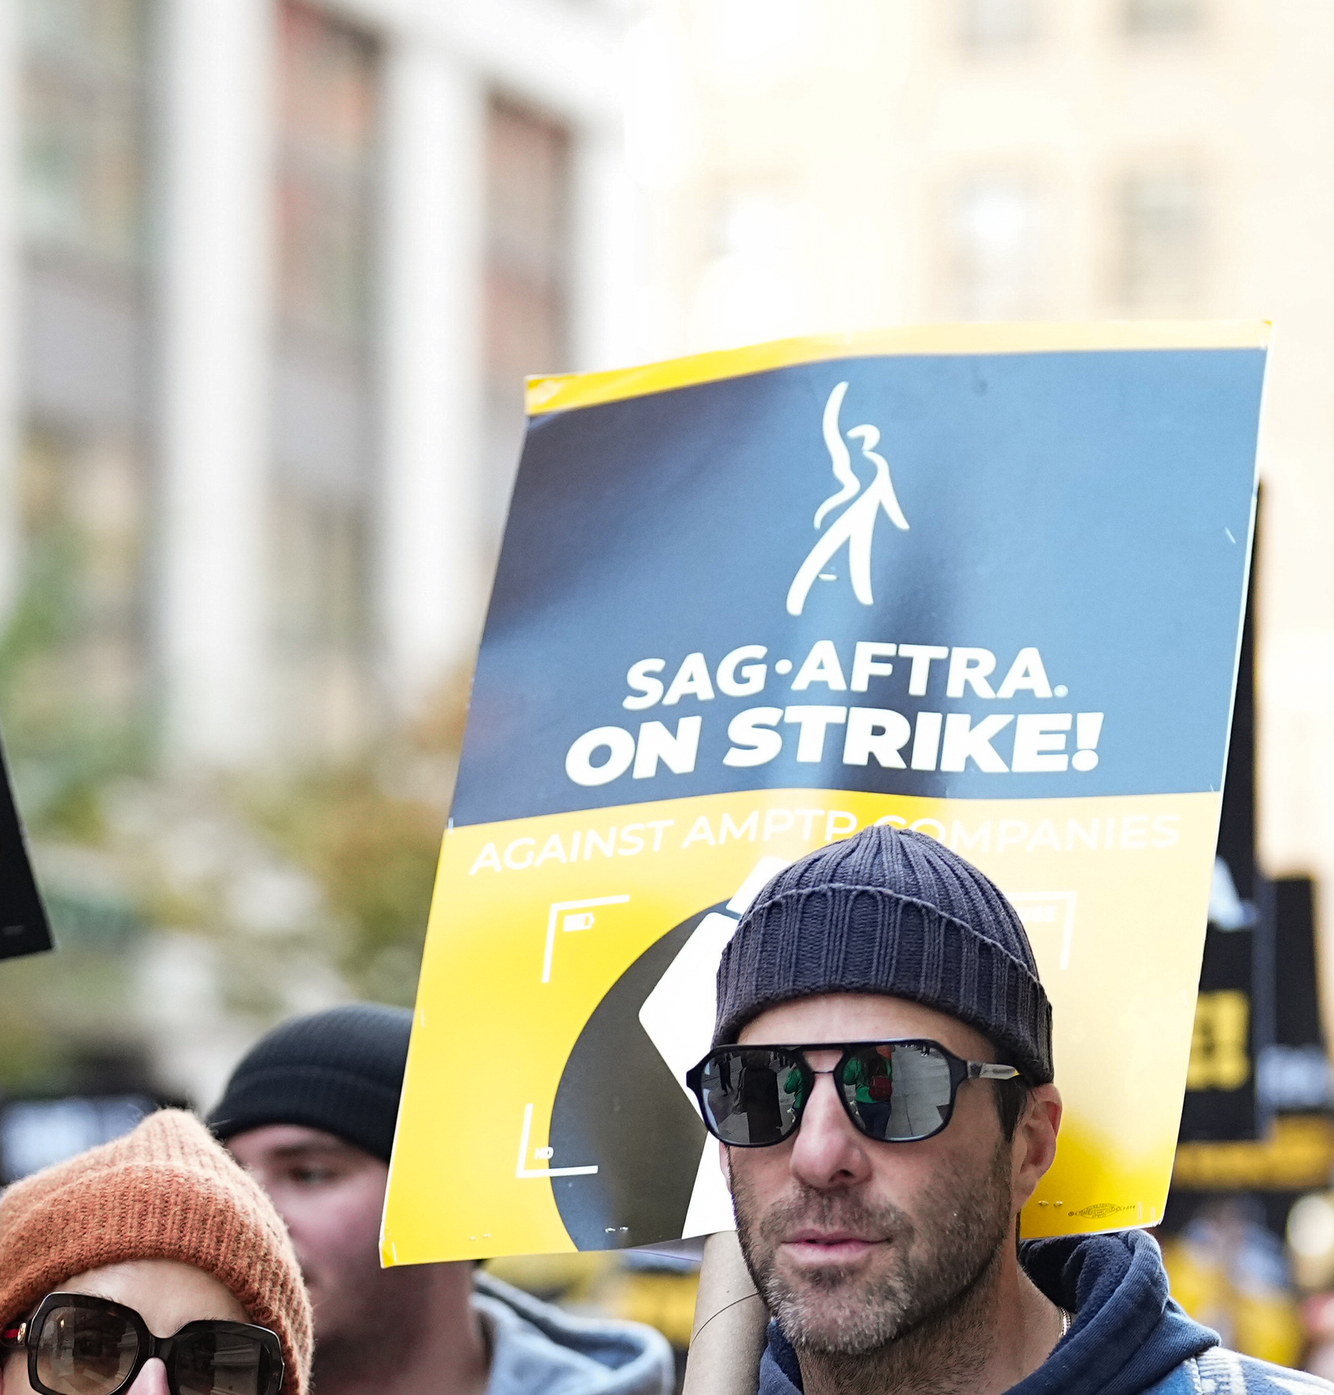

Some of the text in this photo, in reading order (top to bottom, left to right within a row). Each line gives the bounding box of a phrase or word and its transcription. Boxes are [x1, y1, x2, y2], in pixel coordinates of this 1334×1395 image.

[565, 704, 1105, 787] ON STRIKE!
[469, 819, 675, 876] AGAINST
[681, 808, 858, 850] AMPTP
